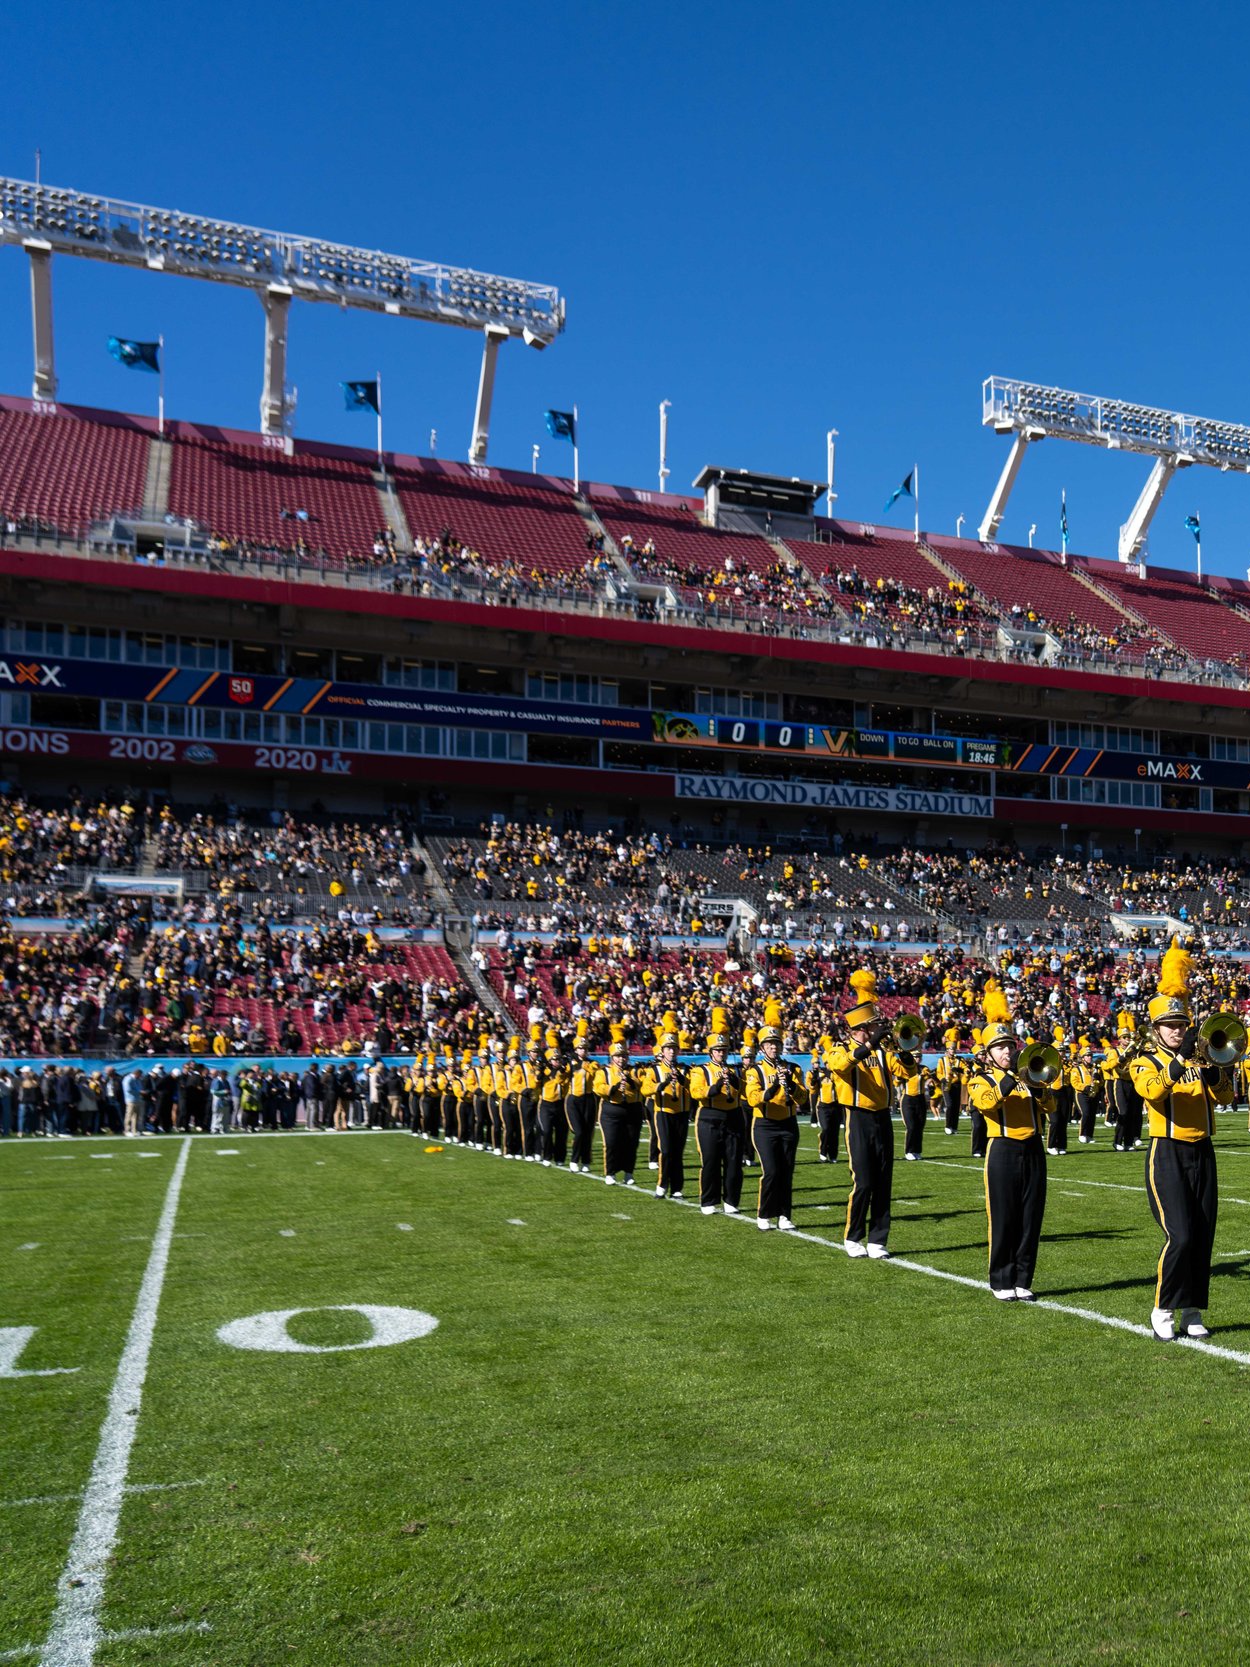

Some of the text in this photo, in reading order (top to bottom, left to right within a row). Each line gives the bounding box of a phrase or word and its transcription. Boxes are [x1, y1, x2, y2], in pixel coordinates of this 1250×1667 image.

[33, 401, 57, 415] 314
[263, 436, 284, 448] 313
[231, 679, 252, 694] 50
[327, 696, 365, 705] OFFICIAL
[367, 698, 423, 711] COMMERCIAL
[423, 703, 467, 714] SPECIALTY
[467, 707, 509, 718] PROPERTY
[517, 711, 555, 722] CASUALTY
[557, 715, 601, 726] INSURANCE
[601, 719, 640, 729] PARTNERS
[731, 722, 792, 747] 0 0
[860, 733, 954, 749] DOWN TO GO BALL ON
[109, 737, 176, 762] 2002
[966, 742, 997, 752] PREGAME
[254, 748, 317, 771] 2020
[968, 752, 995, 764] 18:46
[1137, 760, 1202, 781] eMAXX
[678, 776, 992, 816] RAYMOND JAMES STADIUM
